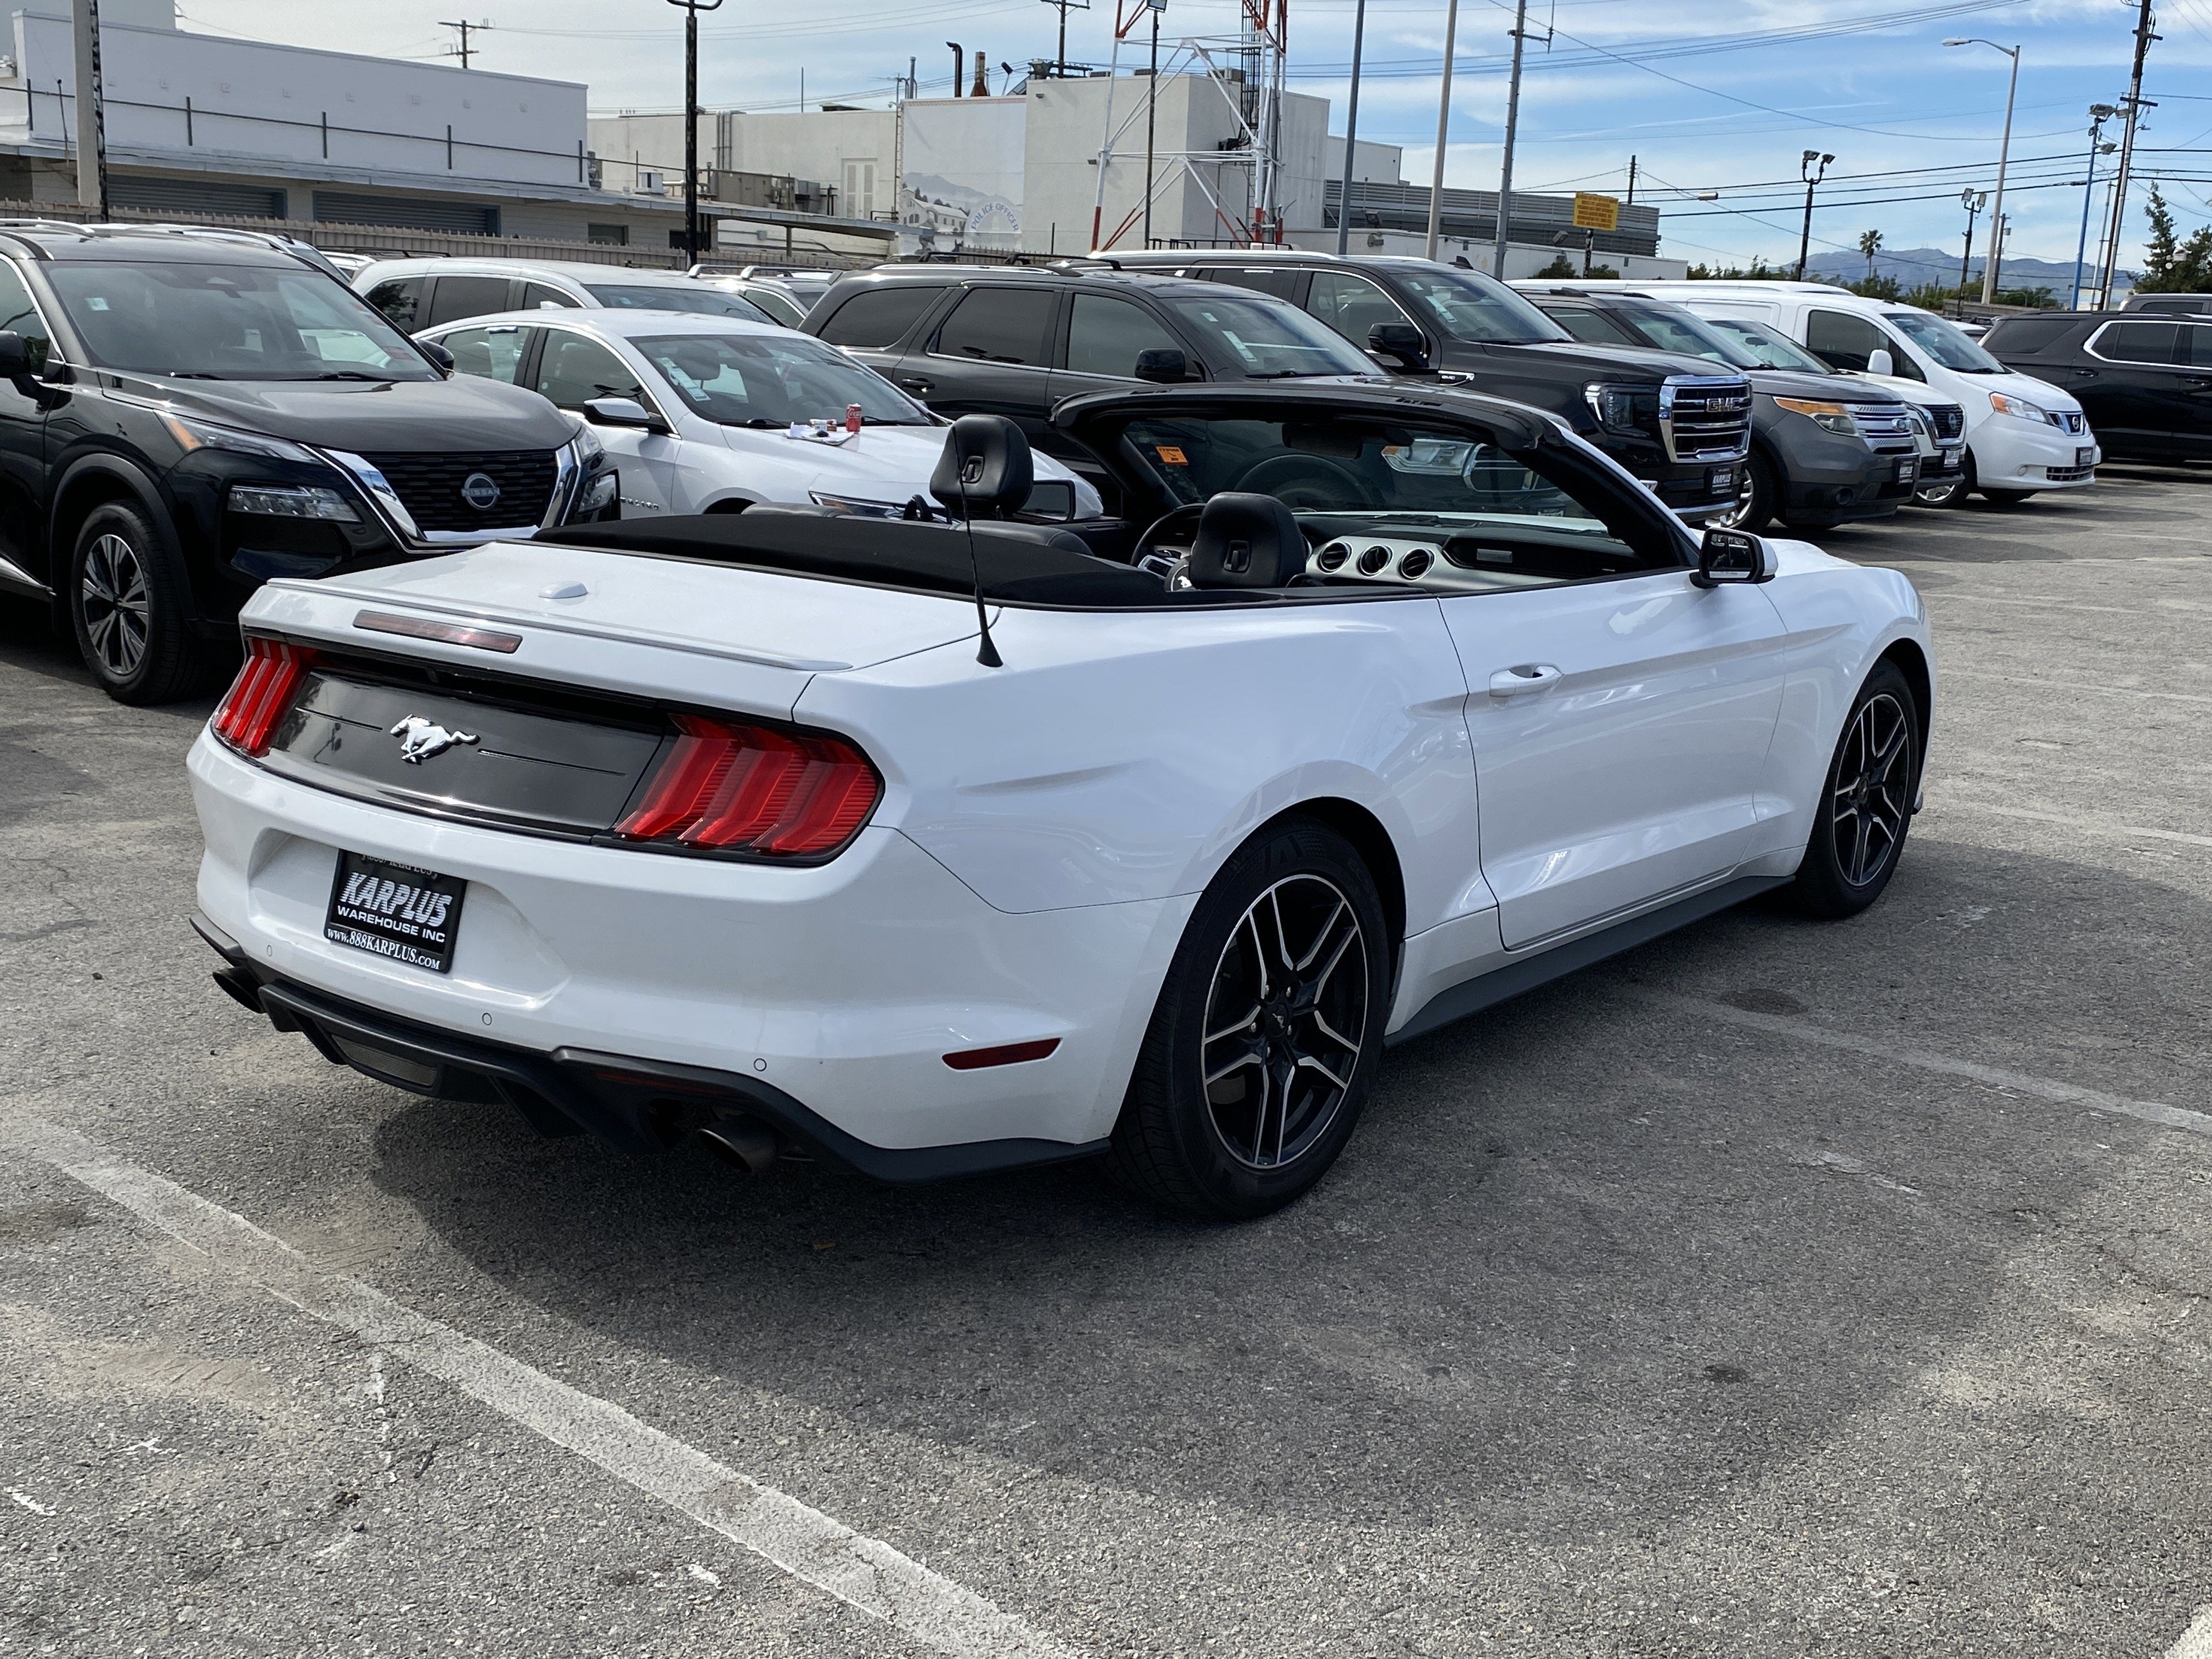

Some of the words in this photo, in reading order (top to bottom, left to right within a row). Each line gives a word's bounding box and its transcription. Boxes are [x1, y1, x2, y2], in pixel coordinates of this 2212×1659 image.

[970, 202, 994, 230] POLICE
[995, 202, 1019, 232] OFFICER
[1706, 397, 1741, 413] GMC
[461, 488, 500, 497] NISSAN
[340, 872, 453, 927] KARPLUS
[337, 905, 419, 936] WAREHOUSE
[422, 929, 445, 943] INC
